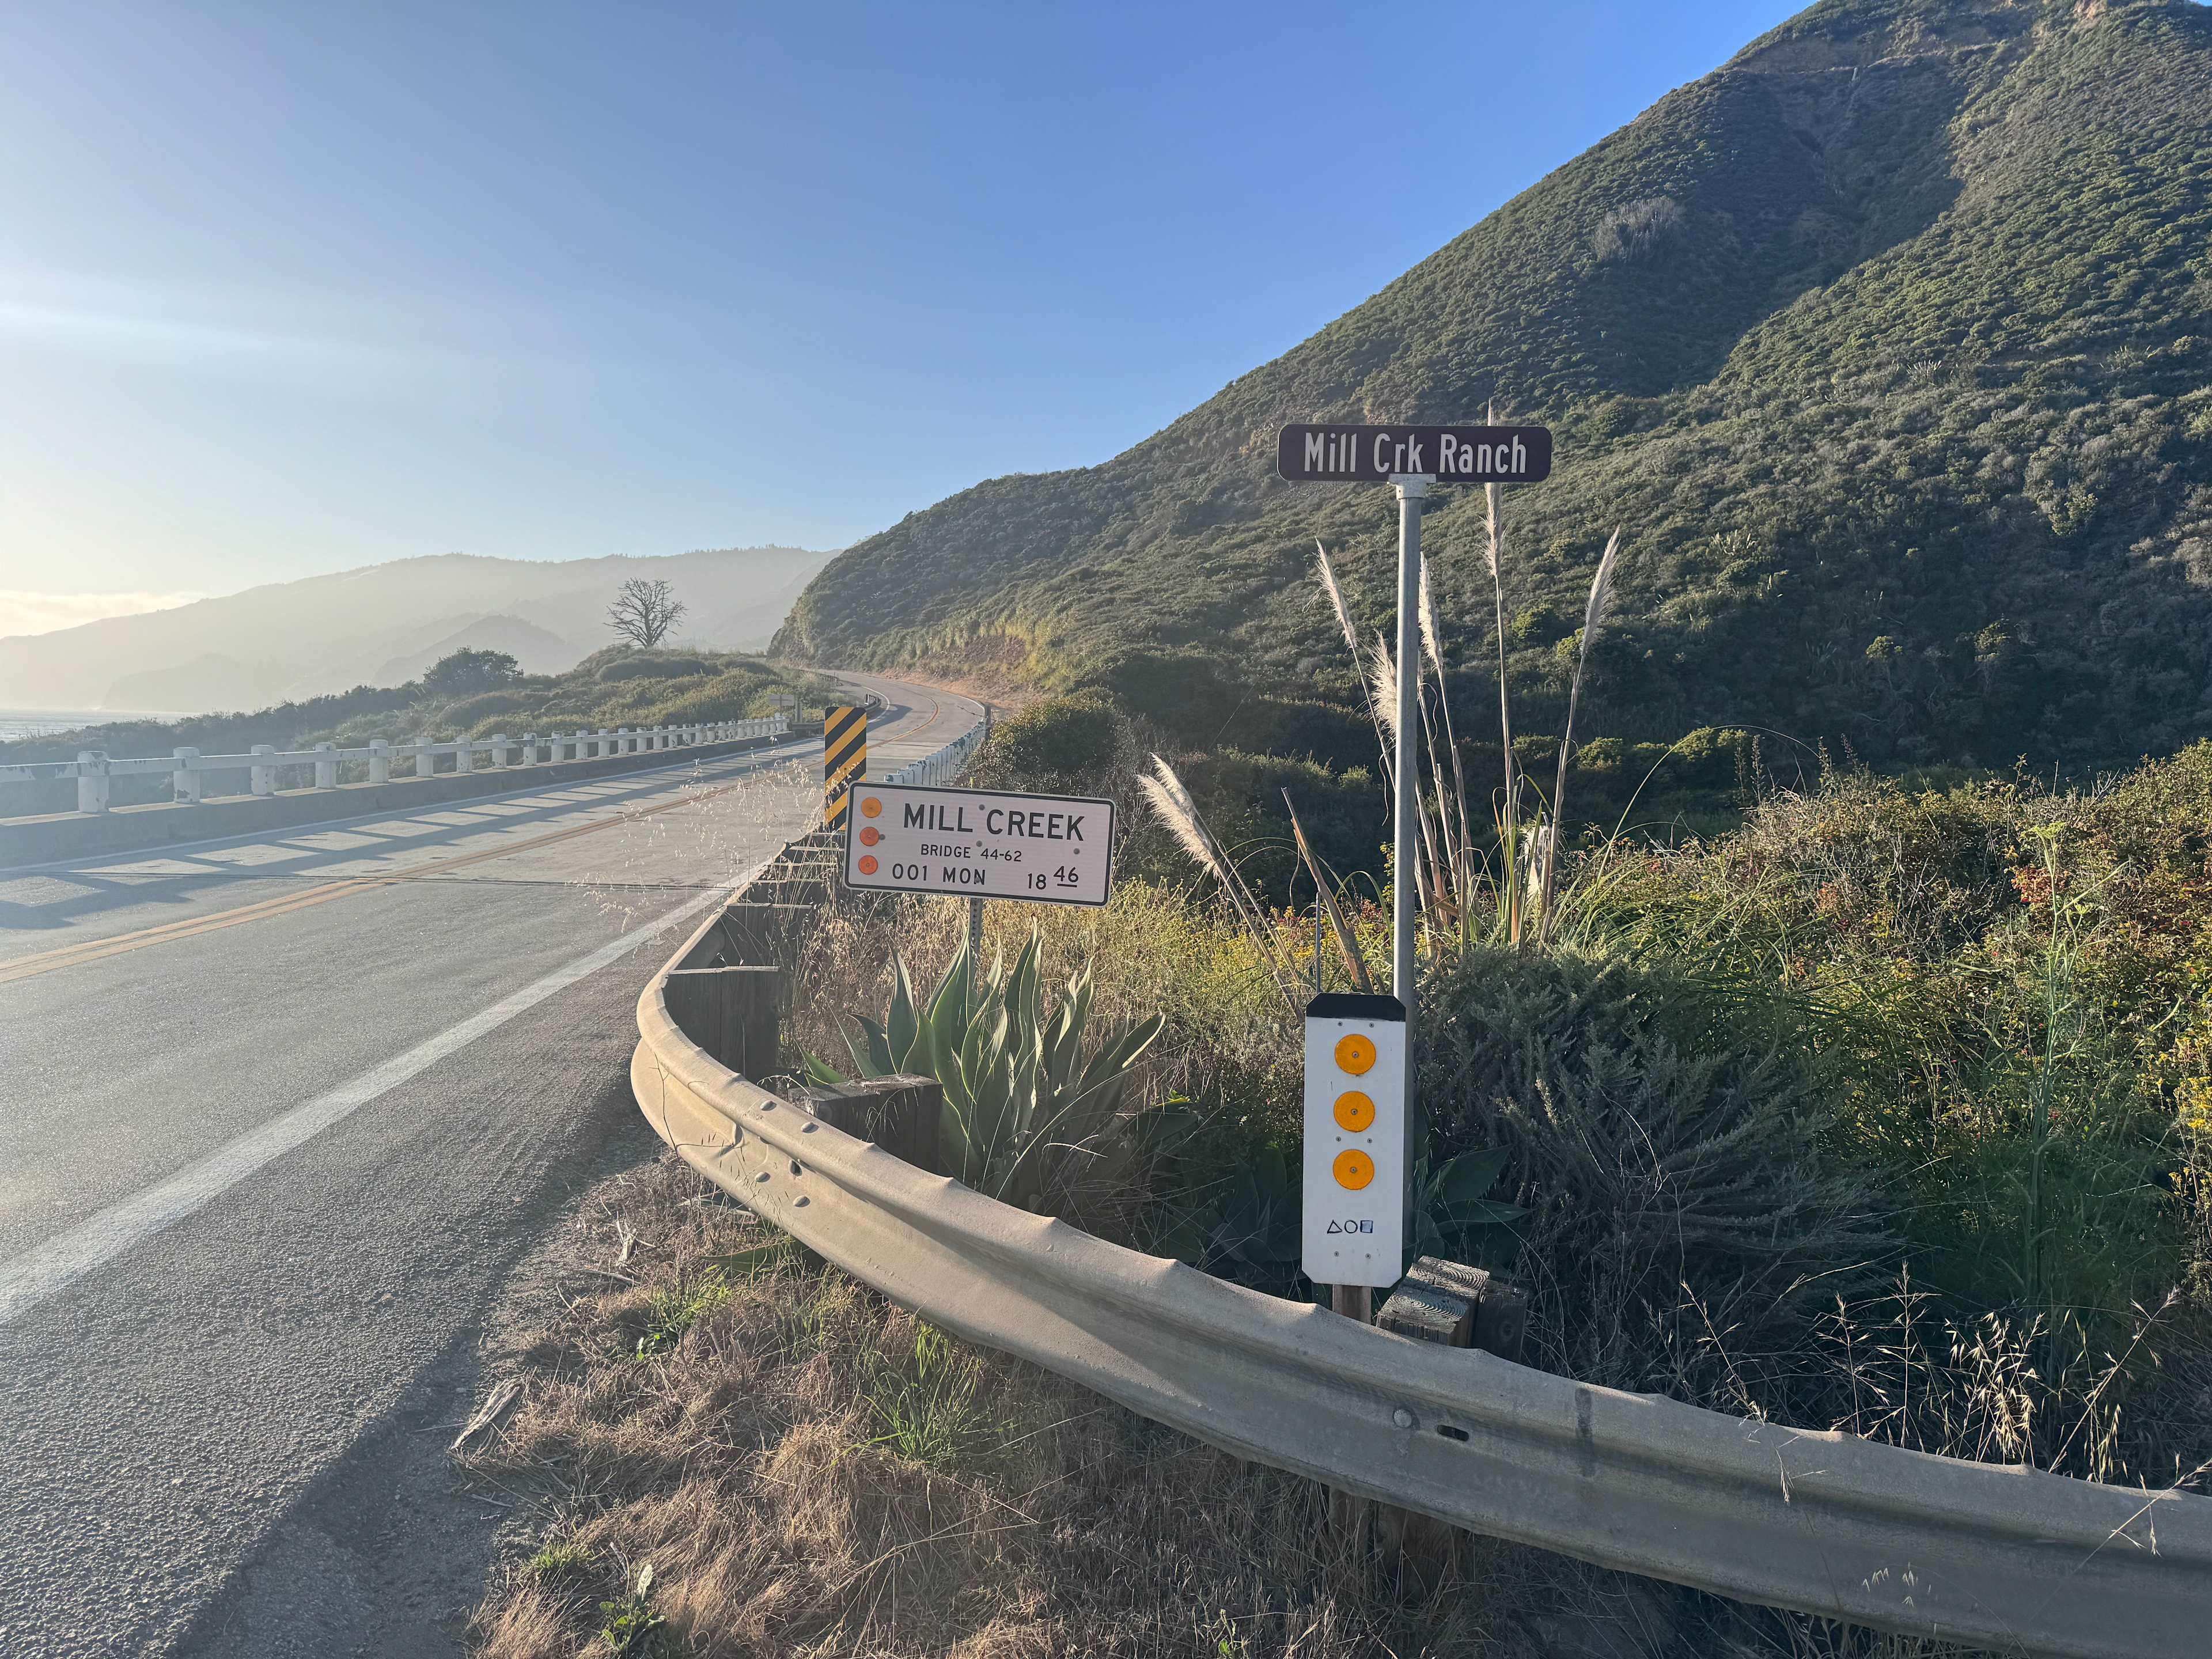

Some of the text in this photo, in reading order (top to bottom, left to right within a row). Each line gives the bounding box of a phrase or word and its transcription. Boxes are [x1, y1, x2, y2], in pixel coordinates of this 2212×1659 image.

[1304, 433, 1526, 474] Mill Crk Ranch
[903, 803, 1085, 841] MILL CREEK
[921, 844, 1022, 862] BRIDGE 44-62
[892, 863, 927, 881] 001
[943, 867, 986, 885] MON
